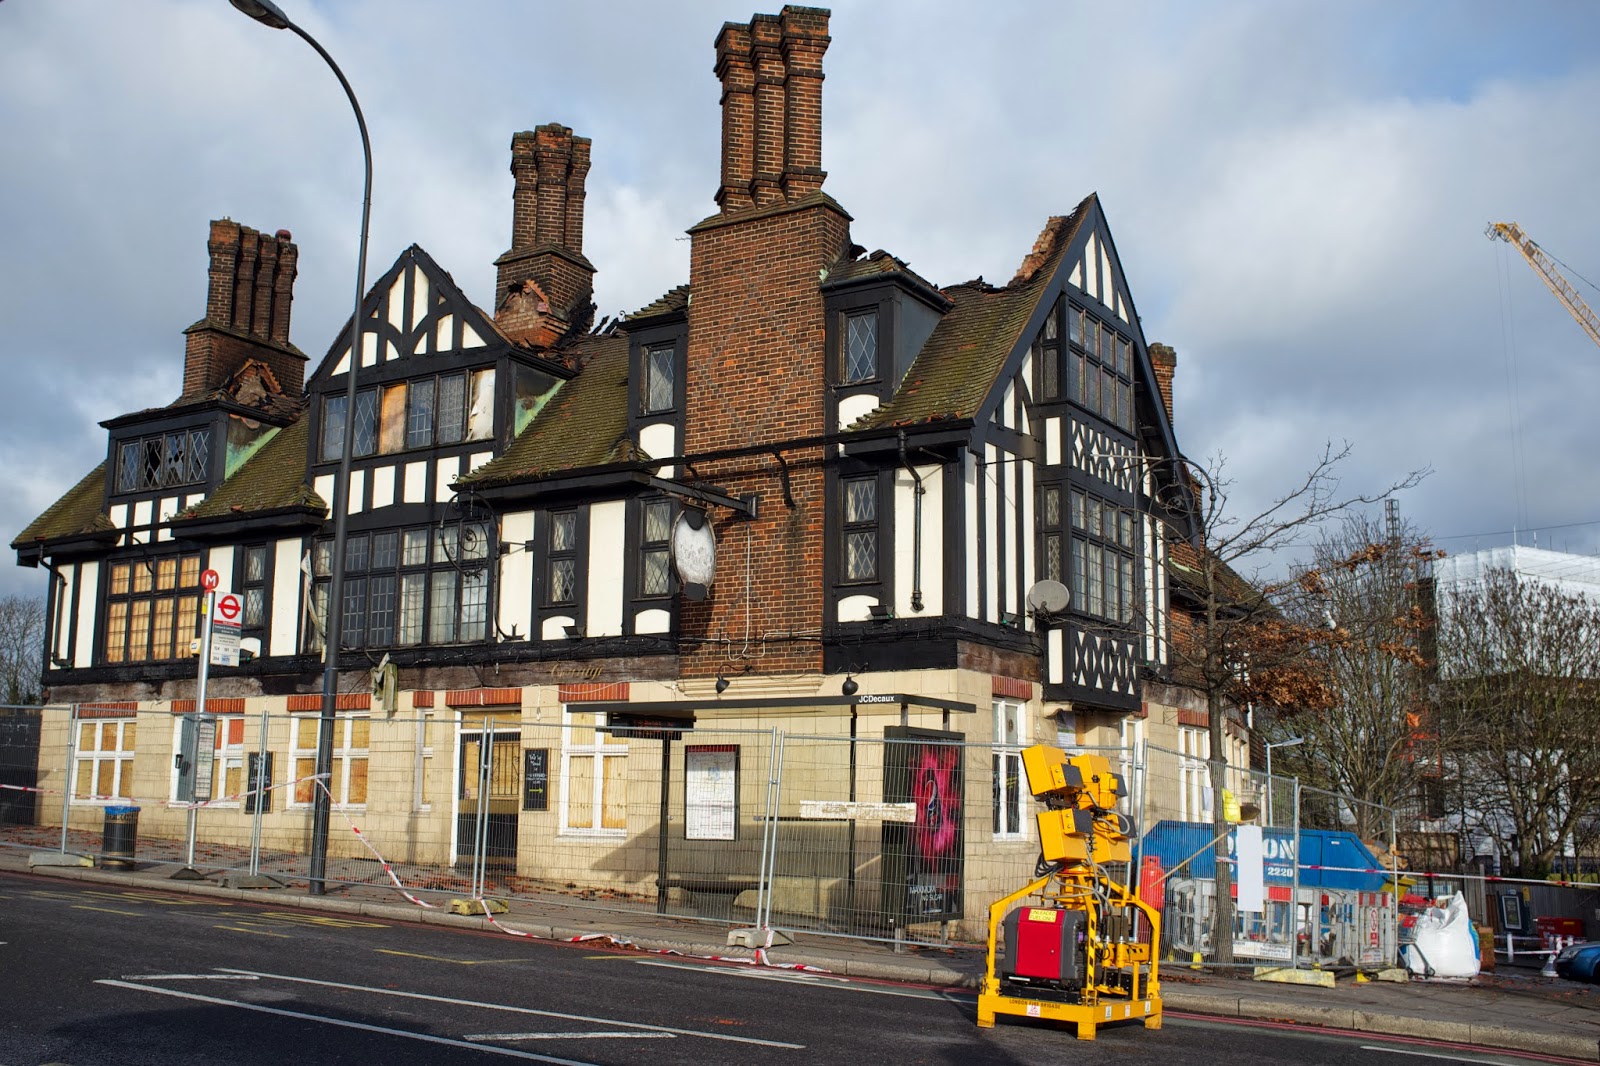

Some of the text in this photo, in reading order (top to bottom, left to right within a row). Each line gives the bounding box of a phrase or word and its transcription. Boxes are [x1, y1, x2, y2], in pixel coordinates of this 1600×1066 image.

[205, 574, 216, 587] M
[858, 695, 895, 703] JCDecaux
[1267, 866, 1294, 878] 2220
